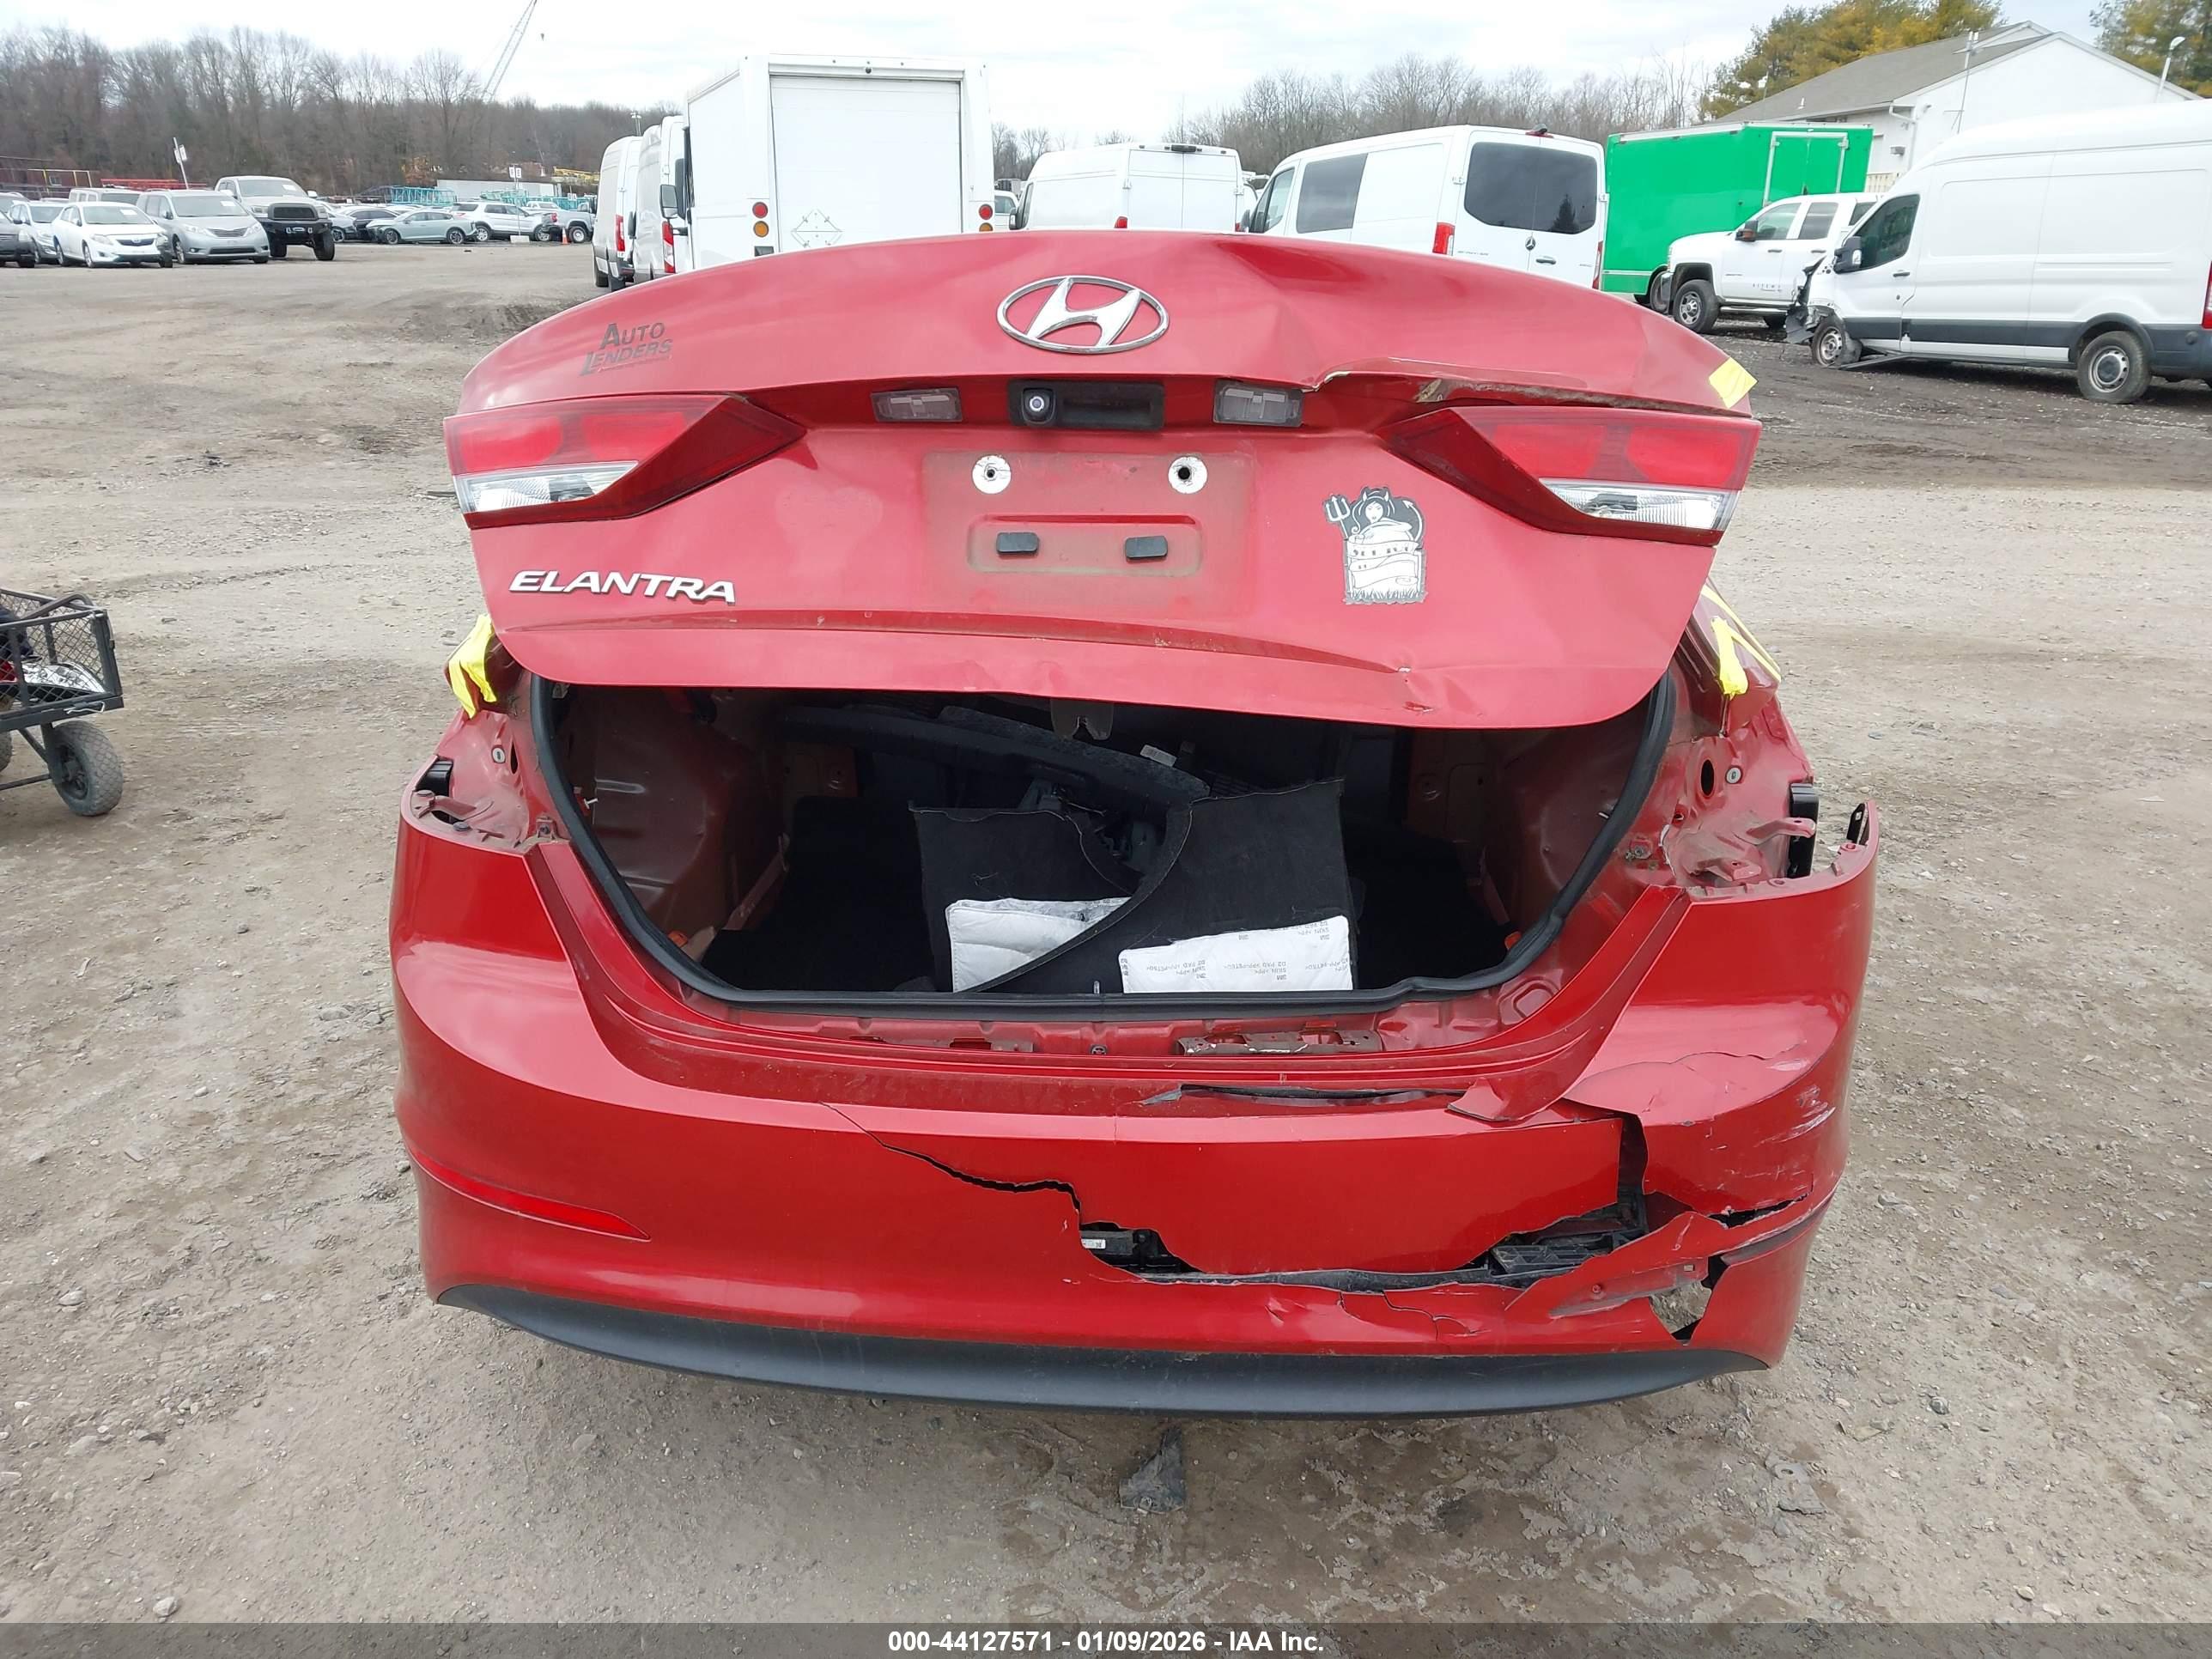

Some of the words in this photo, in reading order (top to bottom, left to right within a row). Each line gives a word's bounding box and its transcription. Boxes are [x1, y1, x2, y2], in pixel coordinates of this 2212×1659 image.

[599, 322, 665, 349] AUTO
[579, 338, 673, 376] LENDERS
[508, 570, 736, 605] ELANTRA
